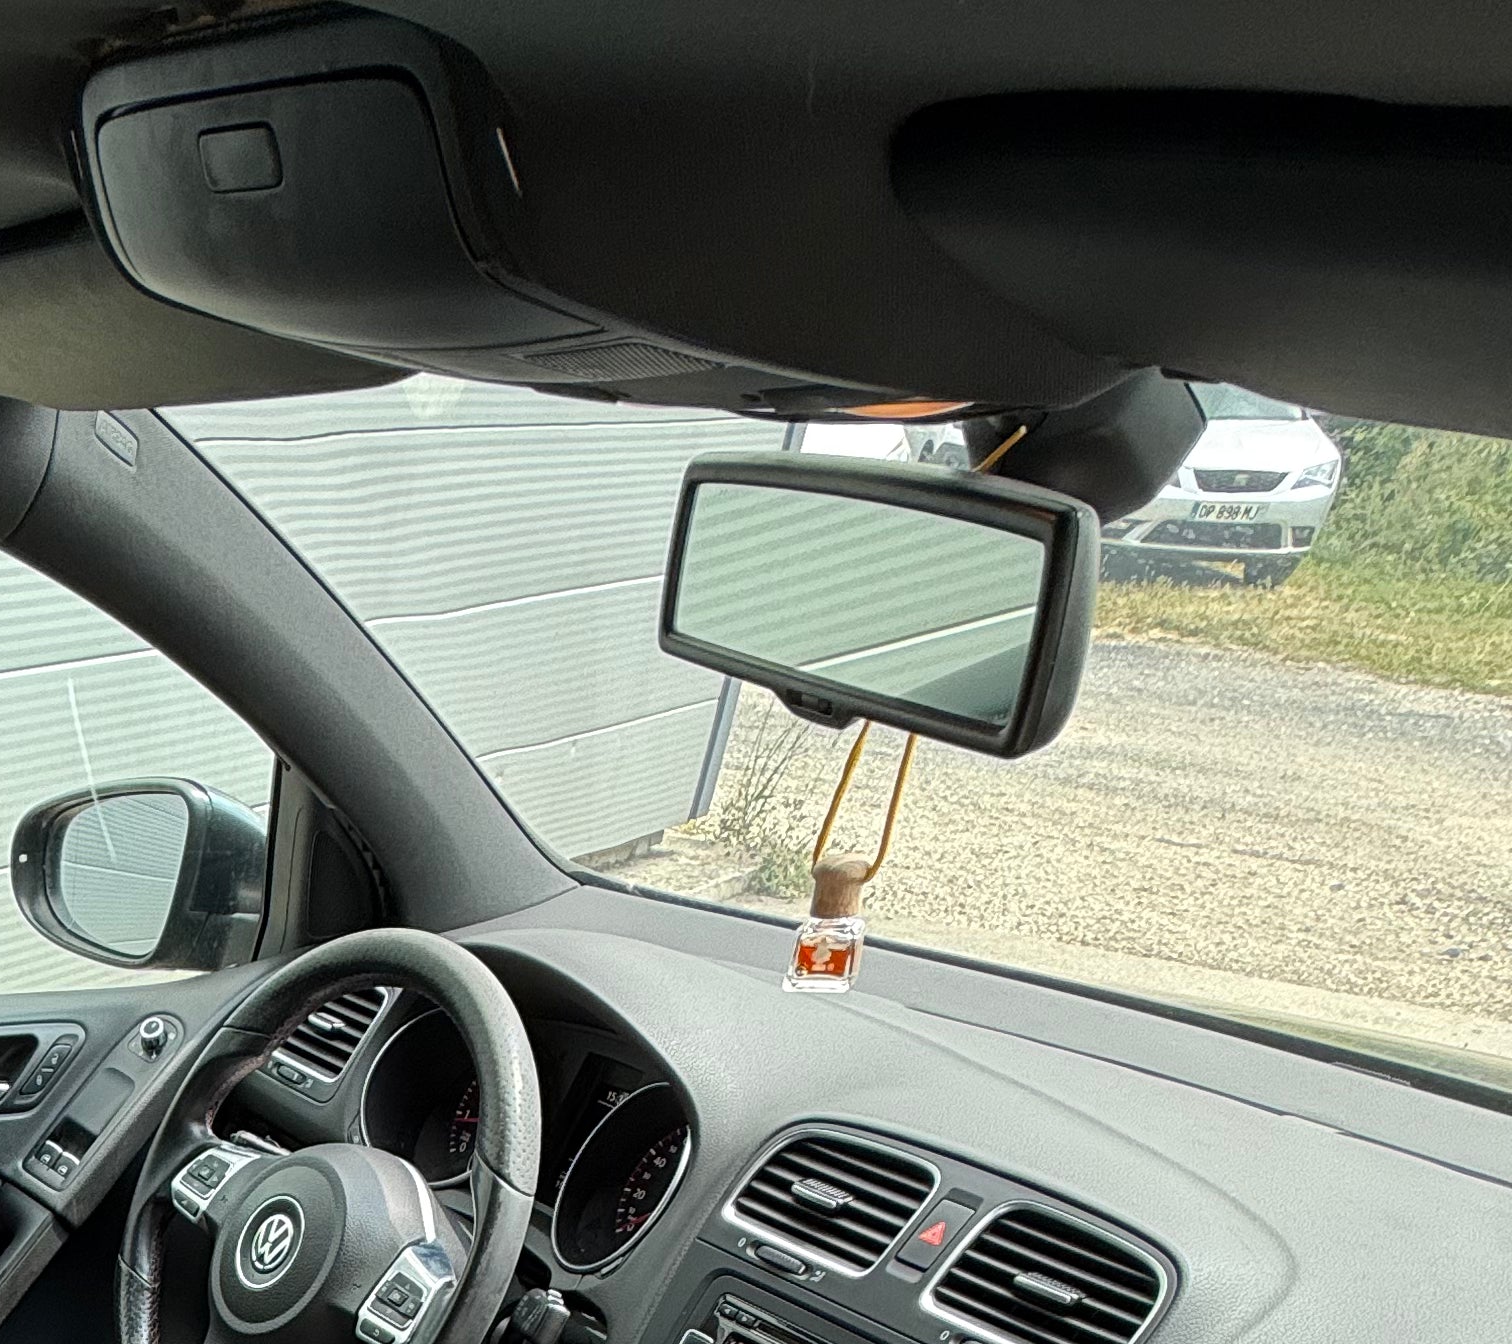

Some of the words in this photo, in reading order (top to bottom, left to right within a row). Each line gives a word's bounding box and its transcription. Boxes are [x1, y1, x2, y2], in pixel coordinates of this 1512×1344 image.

[653, 1156, 667, 1168] 40
[633, 1188, 646, 1200] 20
[738, 1237, 747, 1248] 0
[939, 1330, 950, 1341] 0
